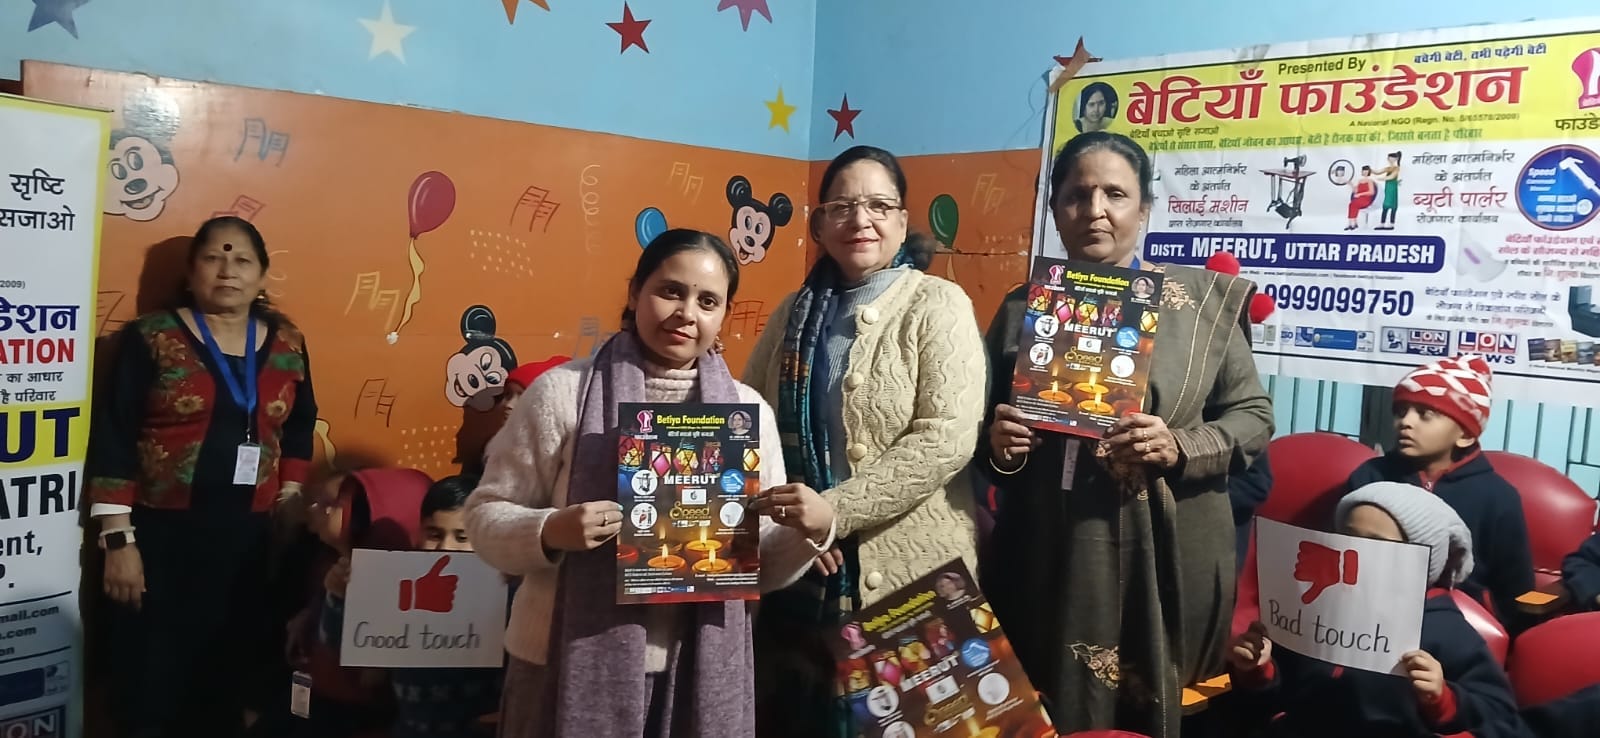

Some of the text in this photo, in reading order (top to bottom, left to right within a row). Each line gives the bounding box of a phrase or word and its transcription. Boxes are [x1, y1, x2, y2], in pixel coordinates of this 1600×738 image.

[1278, 56, 1367, 75] Presented By
[1126, 64, 1529, 125] बेटियाँ फाउंडेशन
[1391, 117, 1411, 125] NGO
[1412, 151, 1447, 165] महिला
[1174, 163, 1200, 177] महिला
[1434, 169, 1447, 182] के
[9, 167, 65, 201] सृष्टि
[1189, 180, 1200, 192] के
[1168, 194, 1249, 217] सिलाई मशीन
[1413, 186, 1509, 214] ब्यूटी पार्लर
[0, 204, 76, 231] सजाओ
[1150, 243, 1186, 257] DISTT.
[1284, 242, 1341, 261] UTTAR
[1345, 244, 1435, 264] PRADESH
[1066, 270, 1089, 283] Betiya
[1089, 273, 1131, 287] Foundation
[1063, 322, 1114, 338] MEERUT
[1411, 330, 1446, 341] LON
[1459, 331, 1517, 349] LON
[1457, 351, 1516, 364] WS
[6, 371, 64, 383] का आधार
[15, 388, 57, 402] परिवार
[656, 414, 726, 426] Betiya Foundation
[0, 407, 81, 463] UT
[663, 474, 718, 485] MEERUT
[0, 626, 37, 640] .com
[1268, 599, 1391, 653] Bad touch
[353, 620, 481, 650] Good touch
